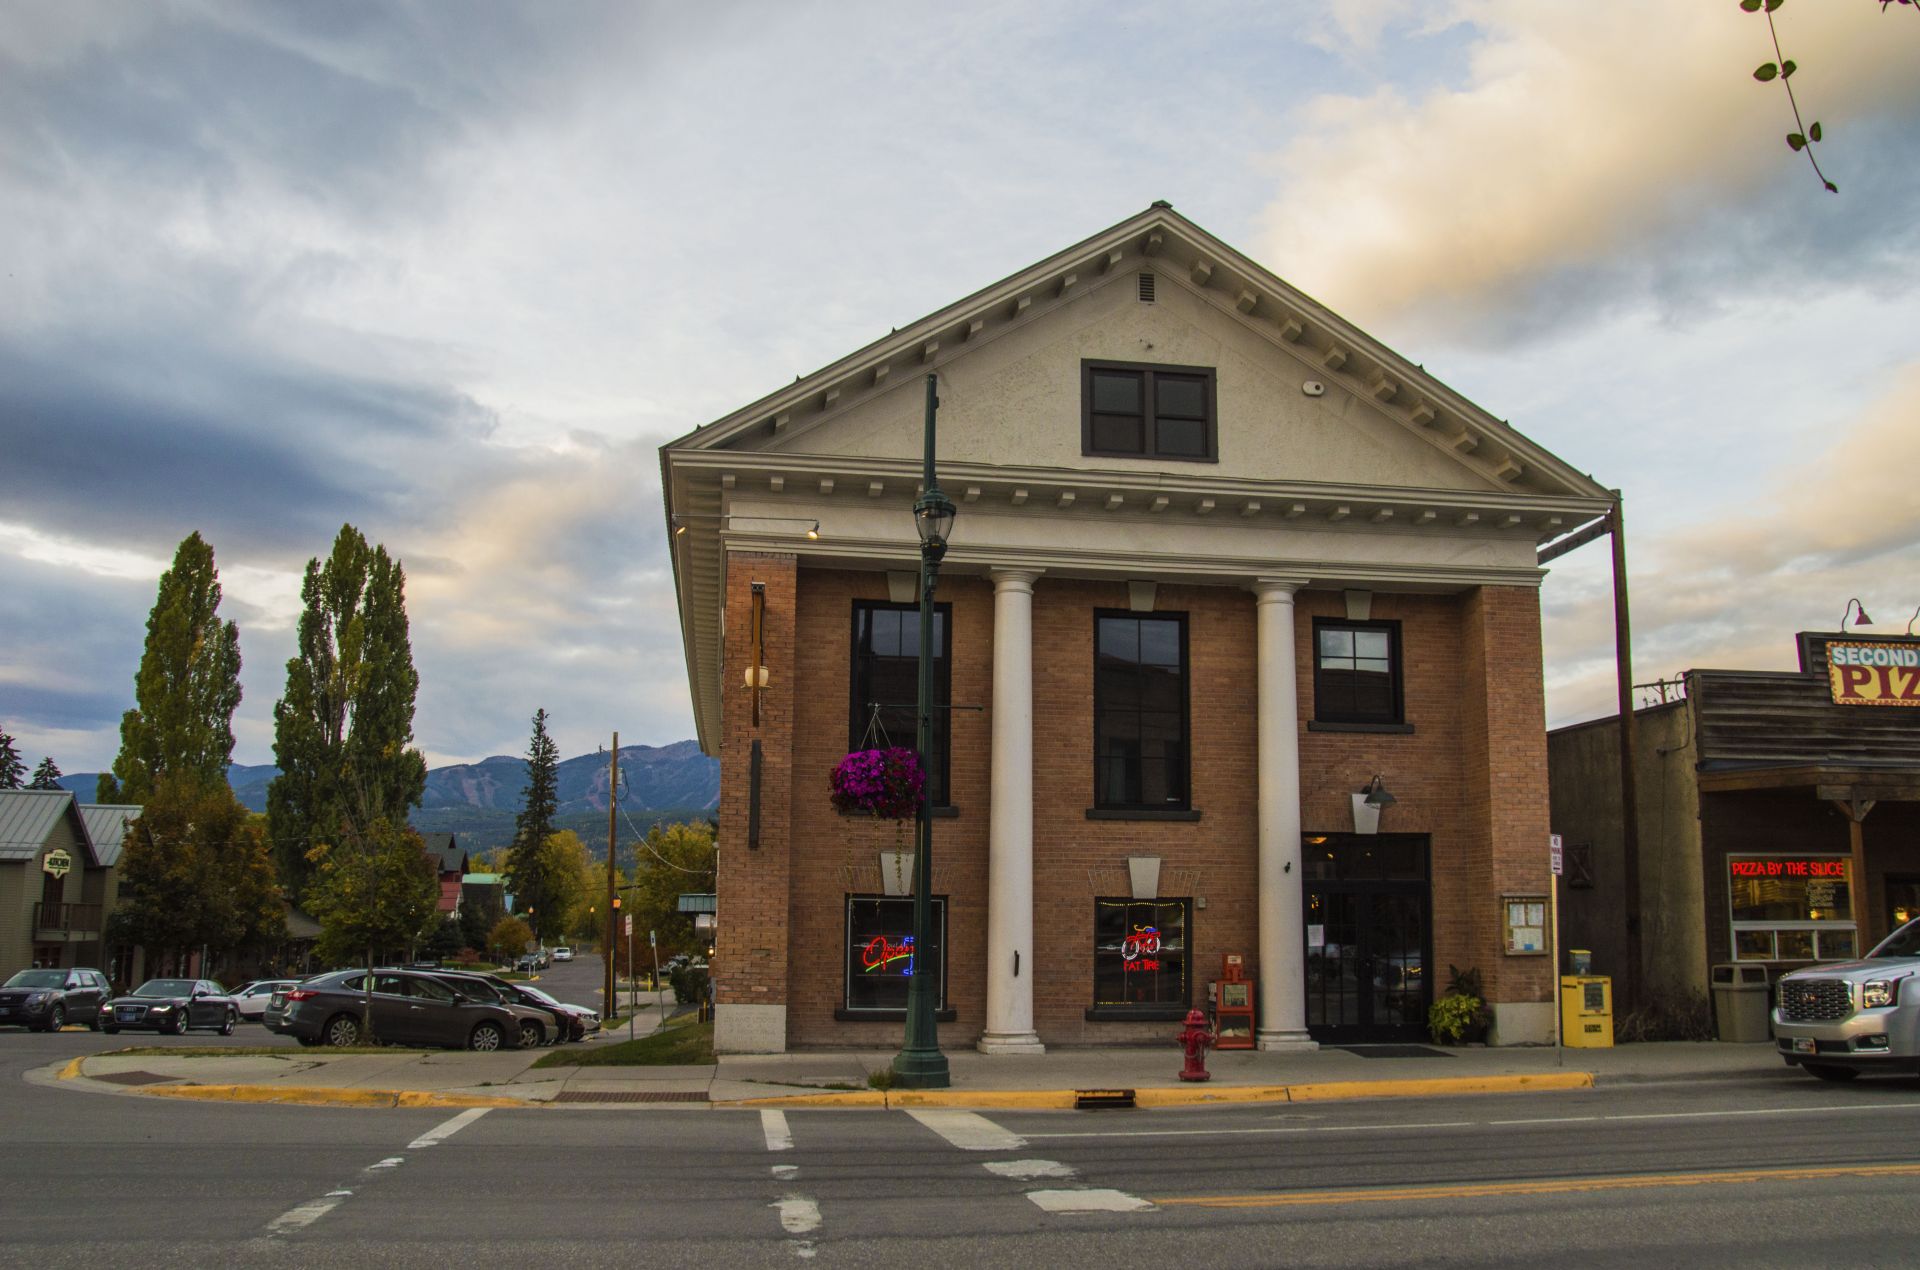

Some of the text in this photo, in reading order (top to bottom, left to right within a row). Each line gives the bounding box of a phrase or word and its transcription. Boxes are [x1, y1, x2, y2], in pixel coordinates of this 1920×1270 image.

[1832, 647, 1918, 666] SECOND
[1732, 861, 1844, 875] PIZZA BY THE SLICE
[1123, 959, 1161, 971] FAT TIRE
